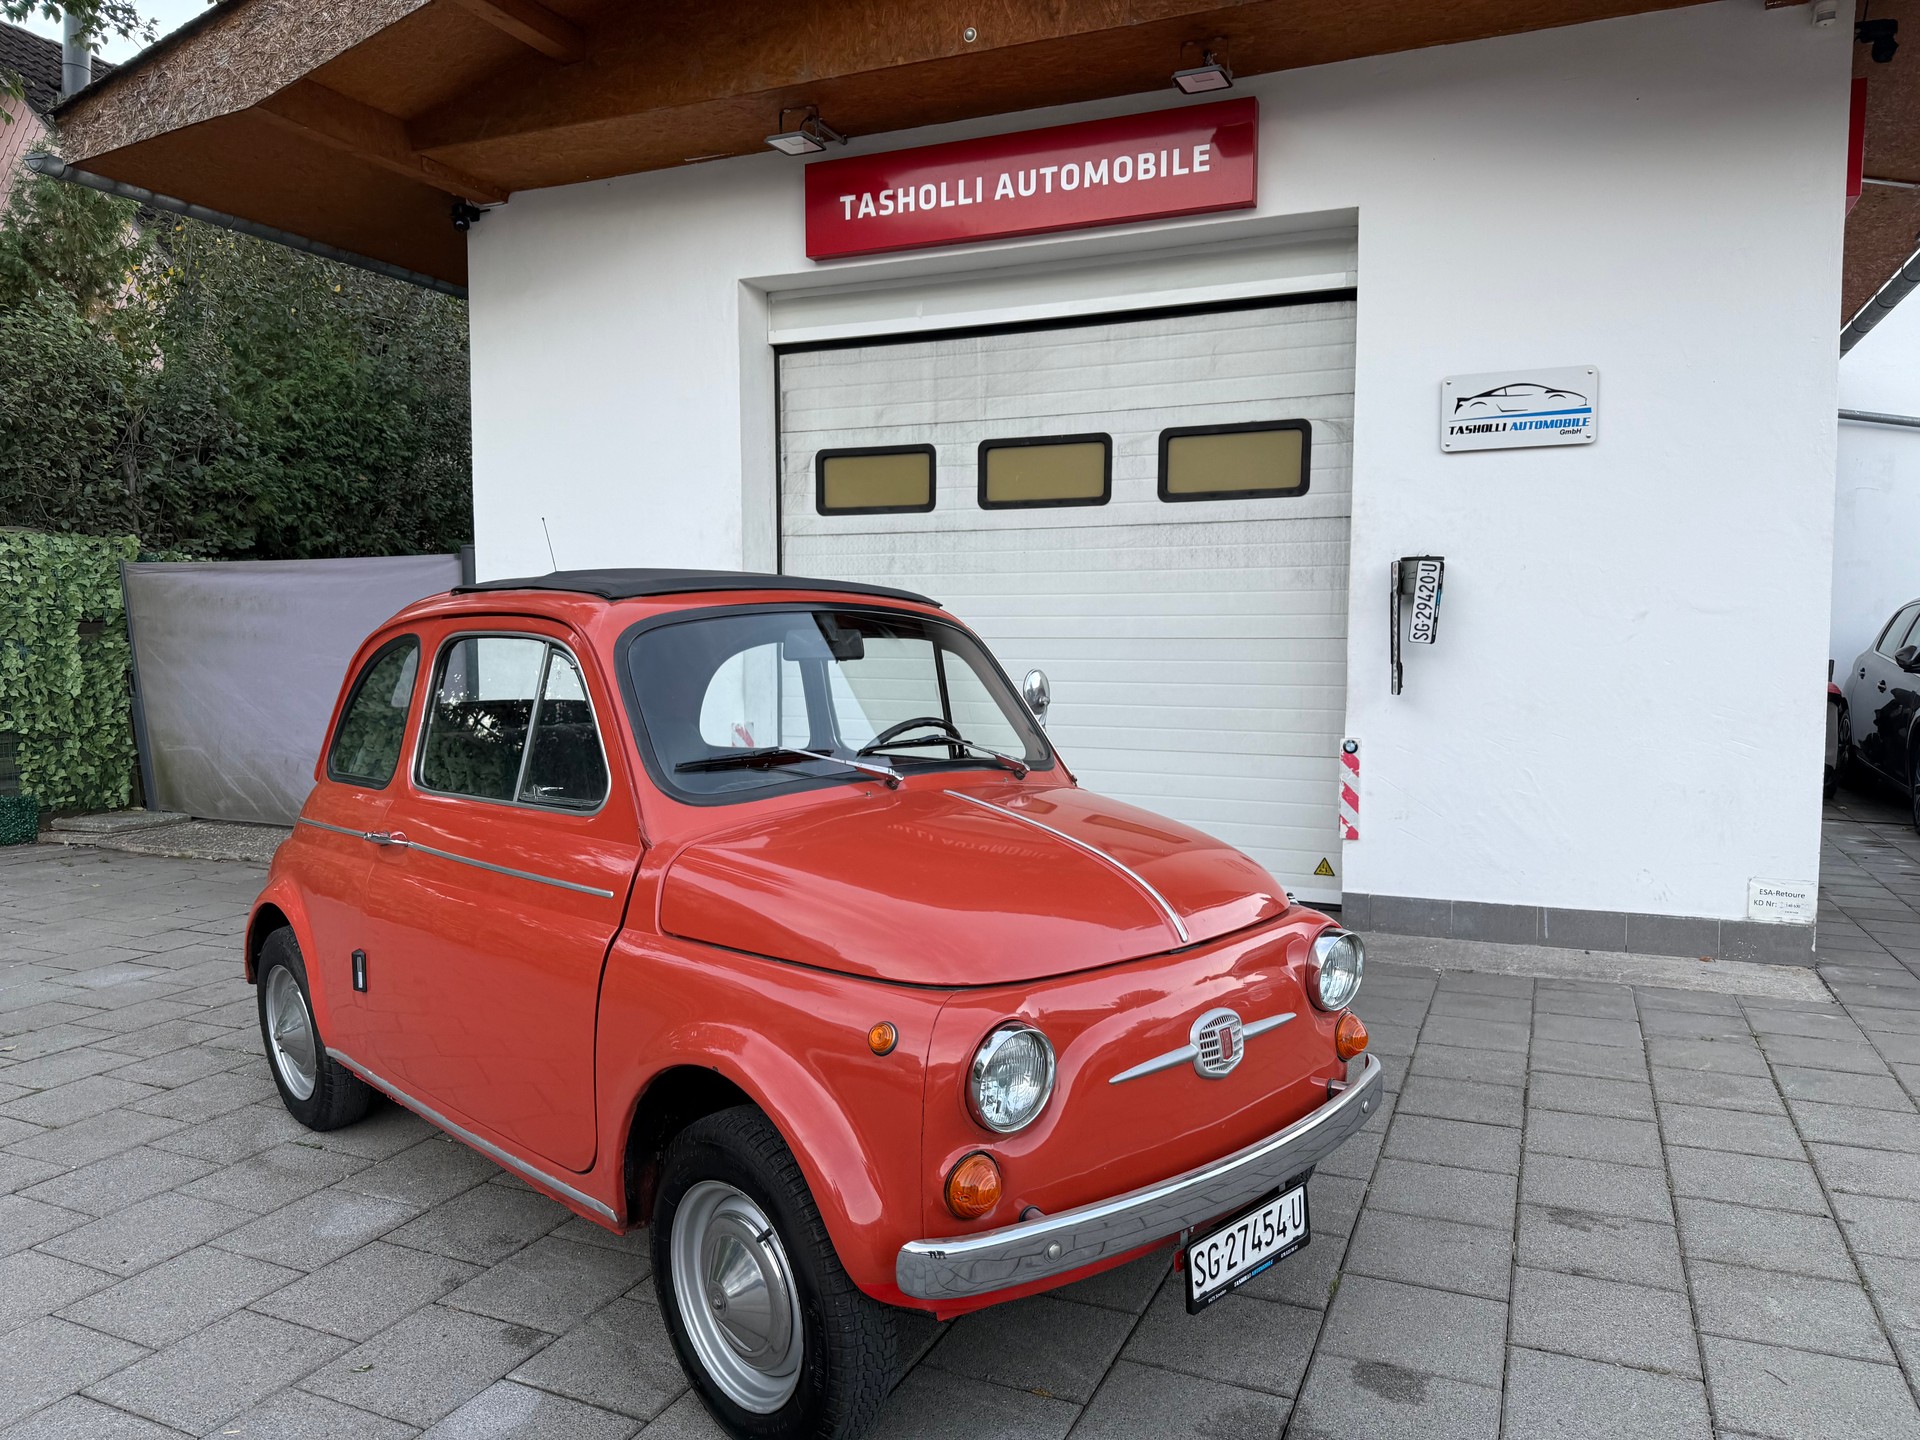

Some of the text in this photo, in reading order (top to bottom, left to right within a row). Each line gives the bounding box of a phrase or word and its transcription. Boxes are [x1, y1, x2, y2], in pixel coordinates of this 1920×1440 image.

[839, 143, 1211, 221] TASHOLLI AUTOMOBILE
[1449, 416, 1591, 436] TASHOLLI AUTOMOBILE
[1559, 428, 1582, 436] GmbH
[1759, 888, 1806, 899] ESA-Retoure
[1765, 900, 1778, 908] Nr:
